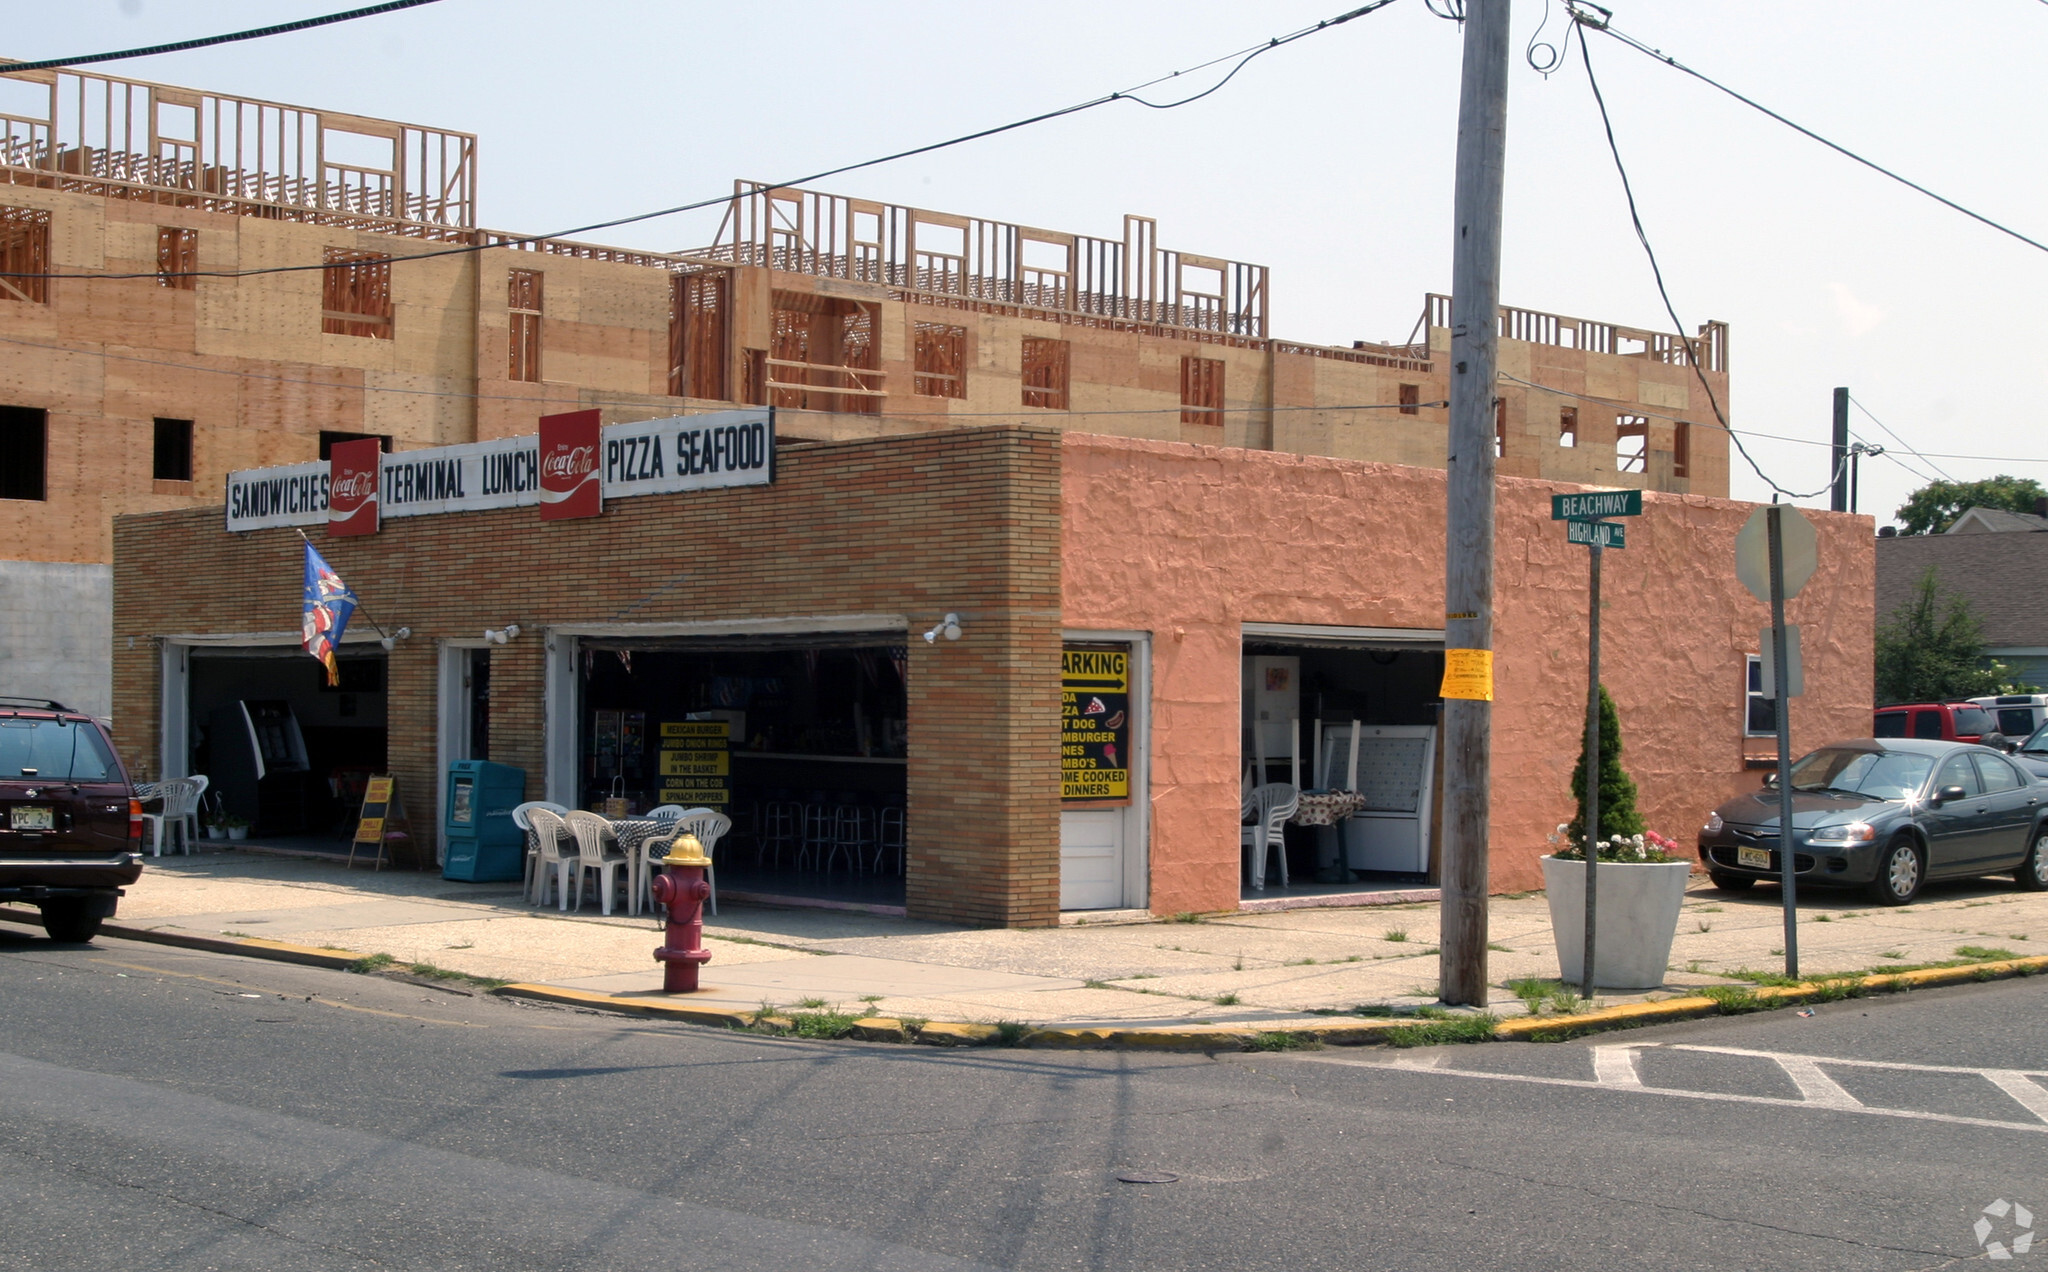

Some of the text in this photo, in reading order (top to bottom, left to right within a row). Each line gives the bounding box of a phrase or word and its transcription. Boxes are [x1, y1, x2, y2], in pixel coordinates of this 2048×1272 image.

[608, 423, 765, 483] PIZZA SEAFOOD
[542, 445, 595, 478] Coca-Cola
[385, 449, 538, 505] TERMINAL LUNCH
[332, 471, 374, 499] Coca-Cola
[232, 474, 329, 519] SANDWICHES
[1562, 494, 1629, 517] BEACHWAY
[1569, 521, 1624, 545] HIGHLAND AVE
[1061, 706, 1079, 716] ZA
[667, 725, 722, 734] MEXICAN BURGER
[1072, 719, 1096, 729] DOG
[1062, 732, 1116, 742] MBURGER
[671, 753, 693, 762] JUMBO
[671, 765, 718, 774] IN THE BASKET
[1082, 771, 1125, 782] COOKED
[665, 778, 684, 788] CORN
[685, 778, 695, 788] ON
[696, 778, 708, 788] THE
[1064, 784, 1110, 795] DINNERS
[666, 791, 724, 801] SPINACH POPPERS
